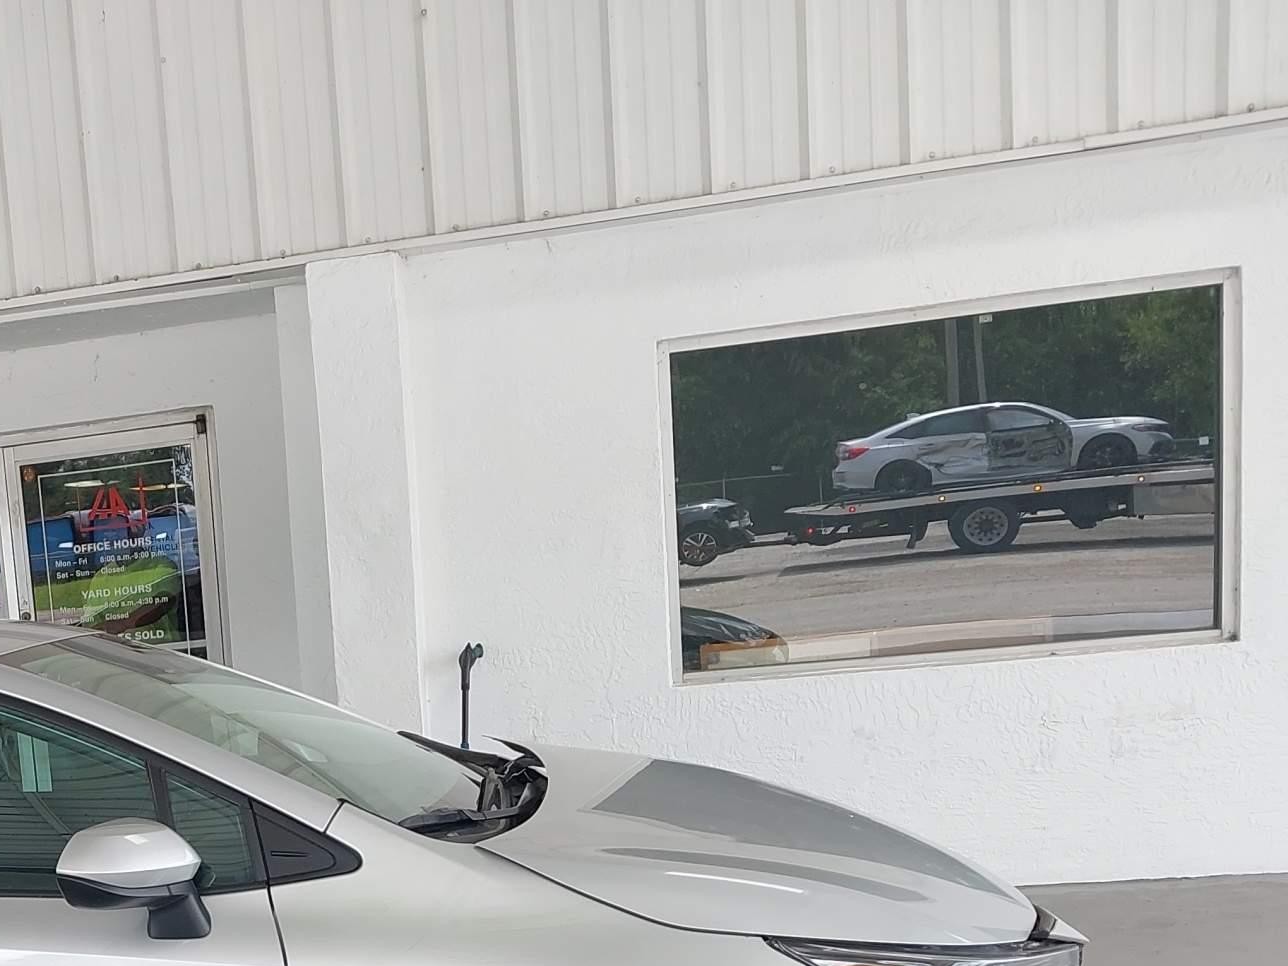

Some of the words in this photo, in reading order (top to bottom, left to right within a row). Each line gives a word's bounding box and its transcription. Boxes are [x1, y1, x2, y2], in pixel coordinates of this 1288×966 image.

[73, 540, 111, 554] OFFICE
[114, 536, 152, 550] HOURS
[55, 560, 72, 568] Mon
[78, 557, 88, 566] Fri
[56, 571, 69, 580] Sat
[75, 569, 90, 578] Sun
[100, 565, 125, 574] Closed
[81, 588, 111, 600] YARD
[114, 583, 152, 597] HOURS
[105, 611, 130, 621] Closed
[134, 630, 165, 640] SOLD
